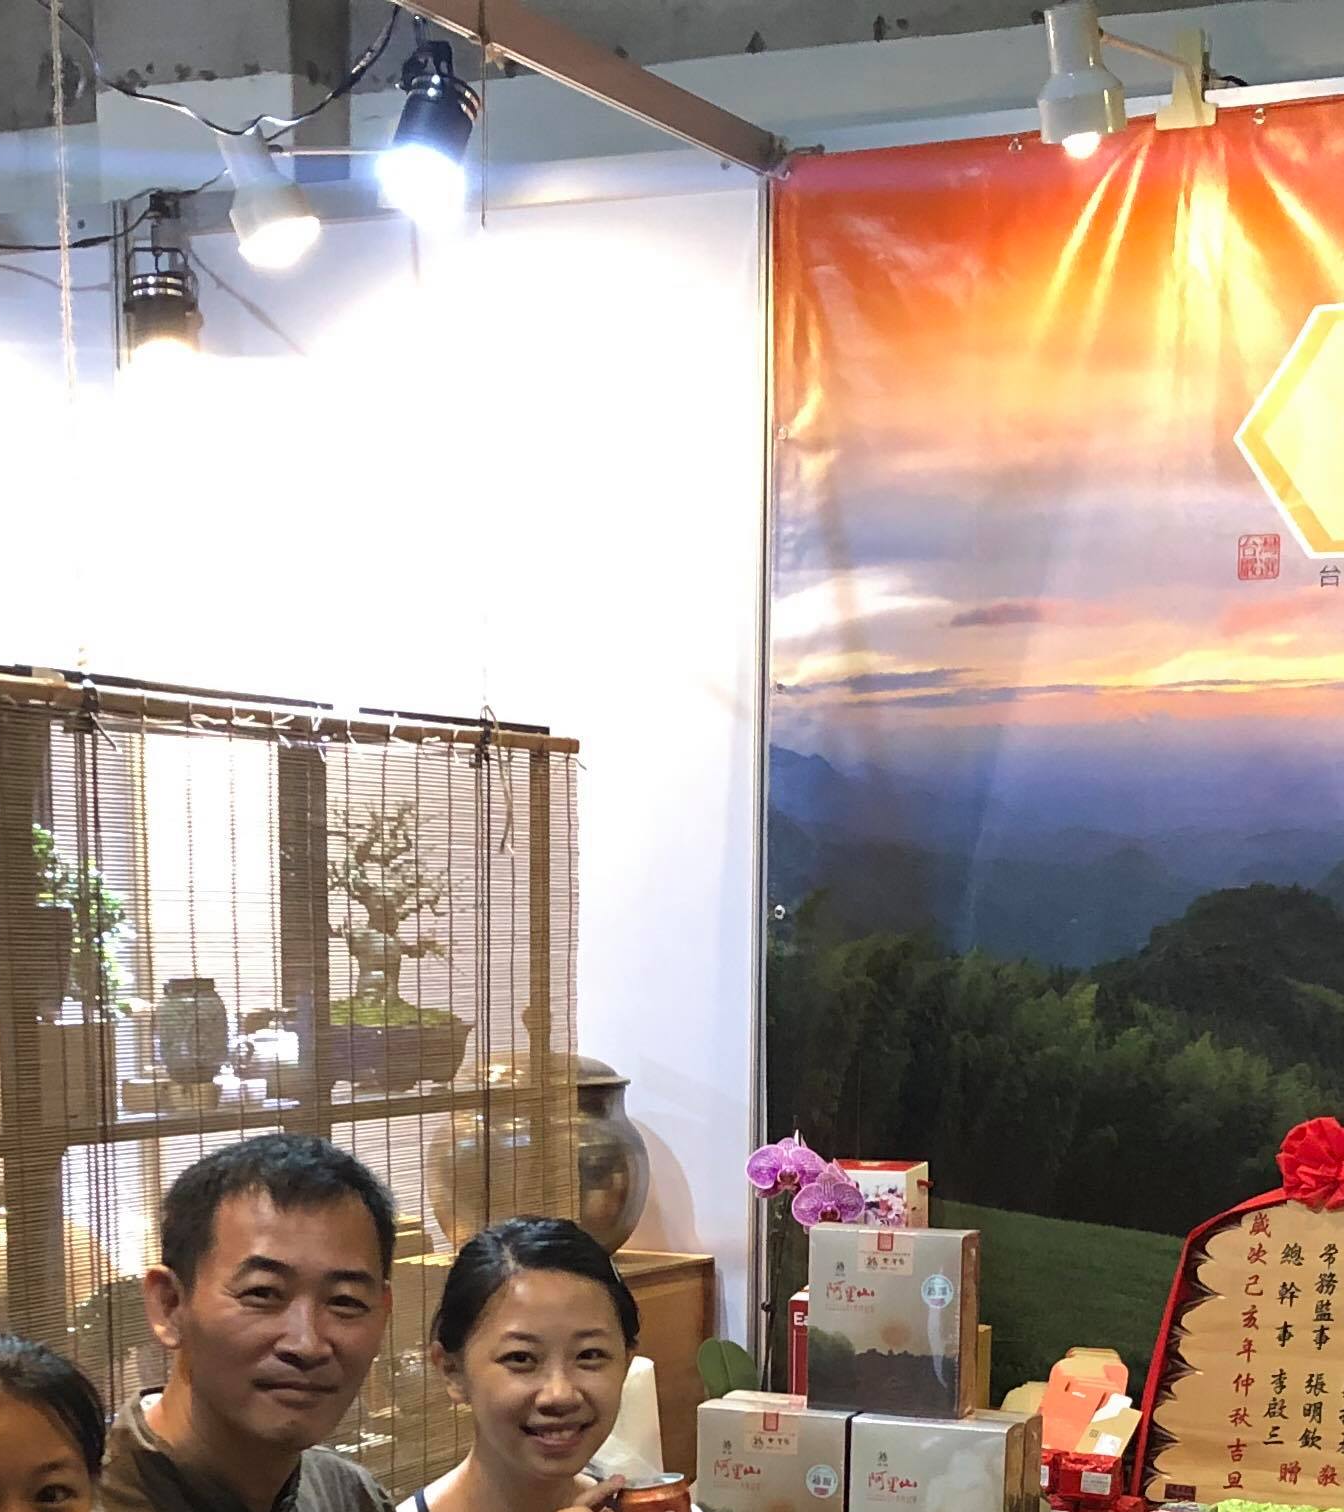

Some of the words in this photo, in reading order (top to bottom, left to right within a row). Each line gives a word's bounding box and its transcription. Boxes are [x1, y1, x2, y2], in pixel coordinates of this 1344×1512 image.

[1275, 1242, 1306, 1348] 總幹事
[1312, 1242, 1340, 1352] 常務監事
